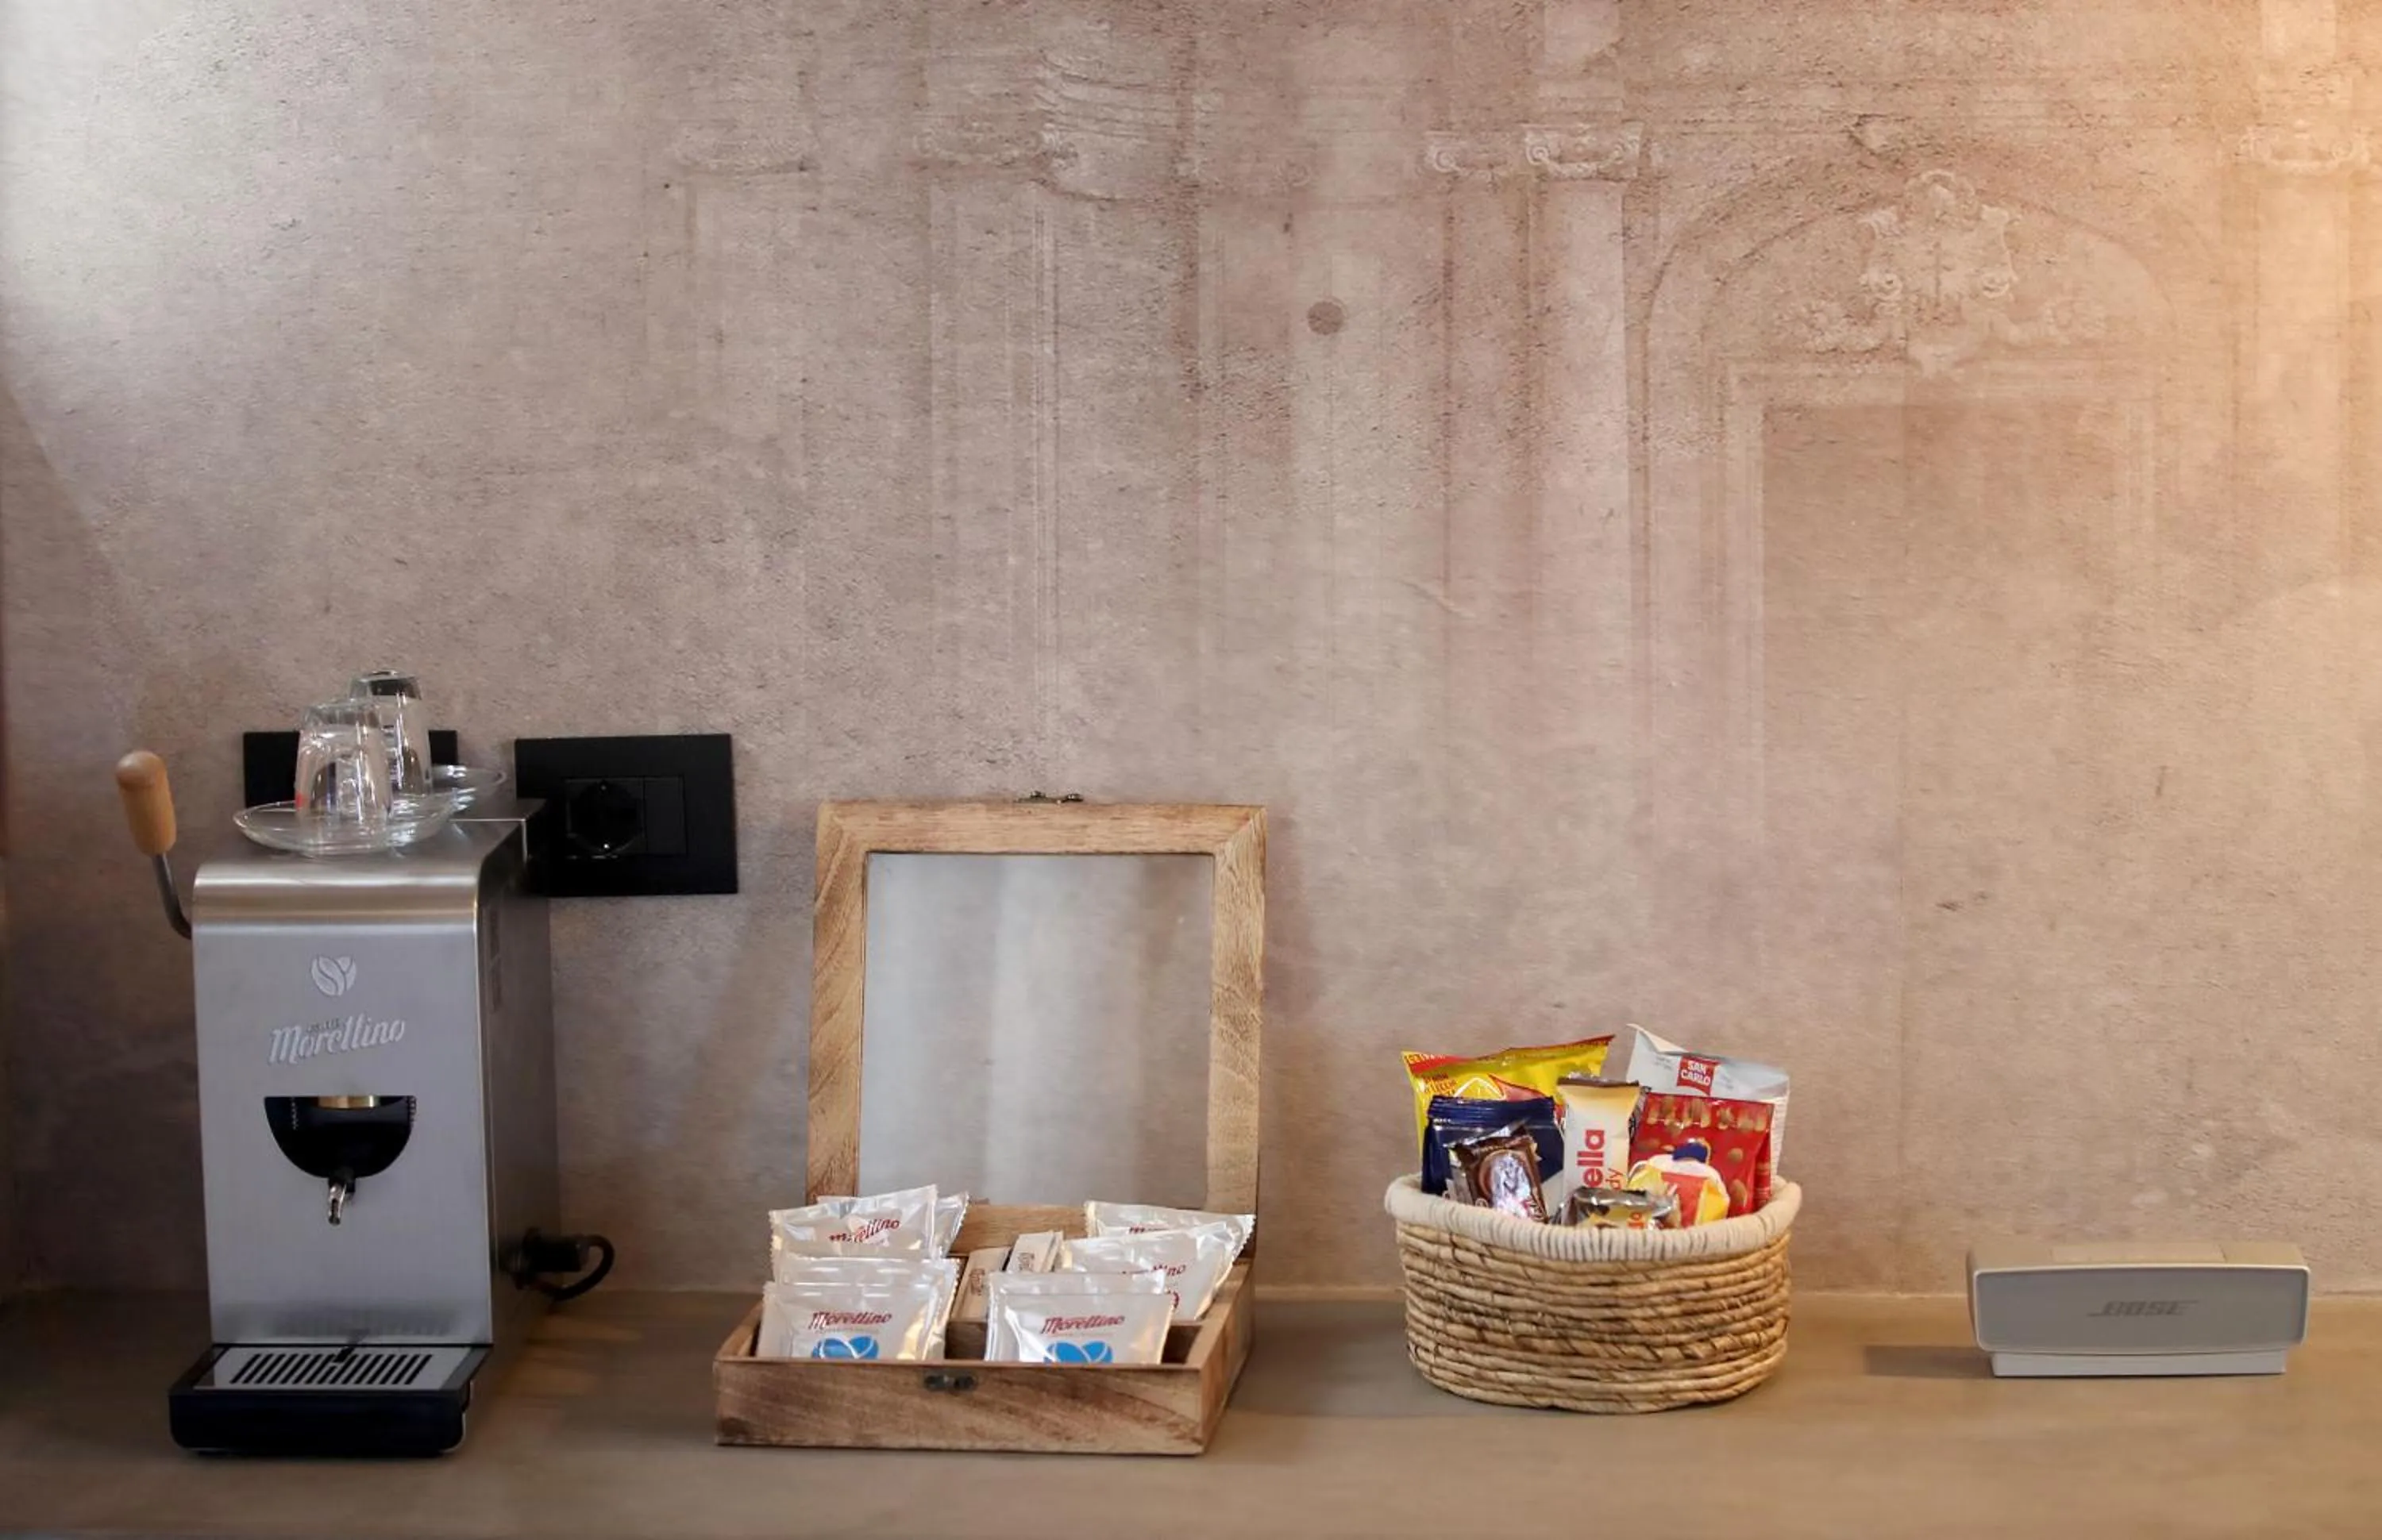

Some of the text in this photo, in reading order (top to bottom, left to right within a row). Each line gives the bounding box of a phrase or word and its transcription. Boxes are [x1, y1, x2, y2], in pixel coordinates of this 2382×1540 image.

[1686, 1059, 1707, 1075] SAN
[1680, 1068, 1711, 1086] CARLO
[1576, 1129, 1605, 1188] ella
[2086, 1299, 2199, 1317] BOSE
